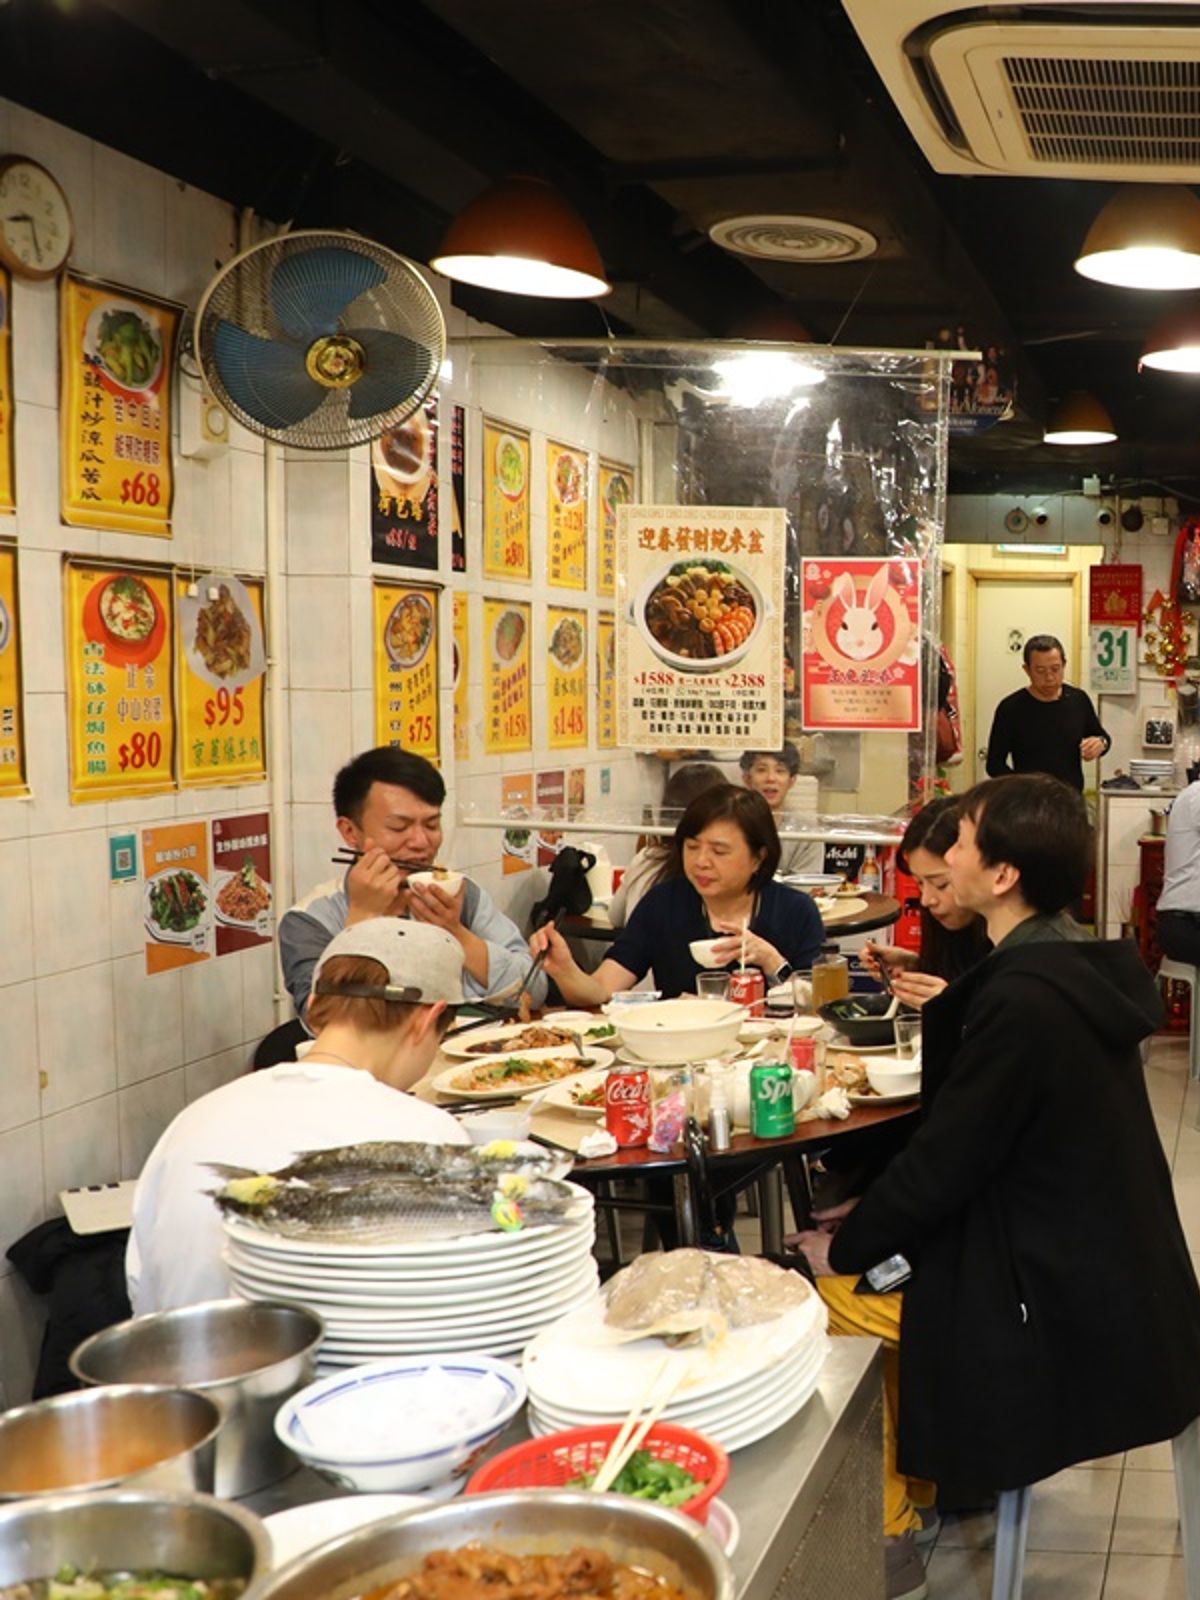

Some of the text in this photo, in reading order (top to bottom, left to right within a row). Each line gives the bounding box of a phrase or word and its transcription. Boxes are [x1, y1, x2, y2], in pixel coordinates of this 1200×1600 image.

[120, 470, 160, 506] $68
[1097, 630, 1129, 668] 31
[204, 686, 245, 729] $95
[409, 715, 433, 744] $75
[118, 731, 162, 773] $80
[826, 846, 858, 860] Asahi
